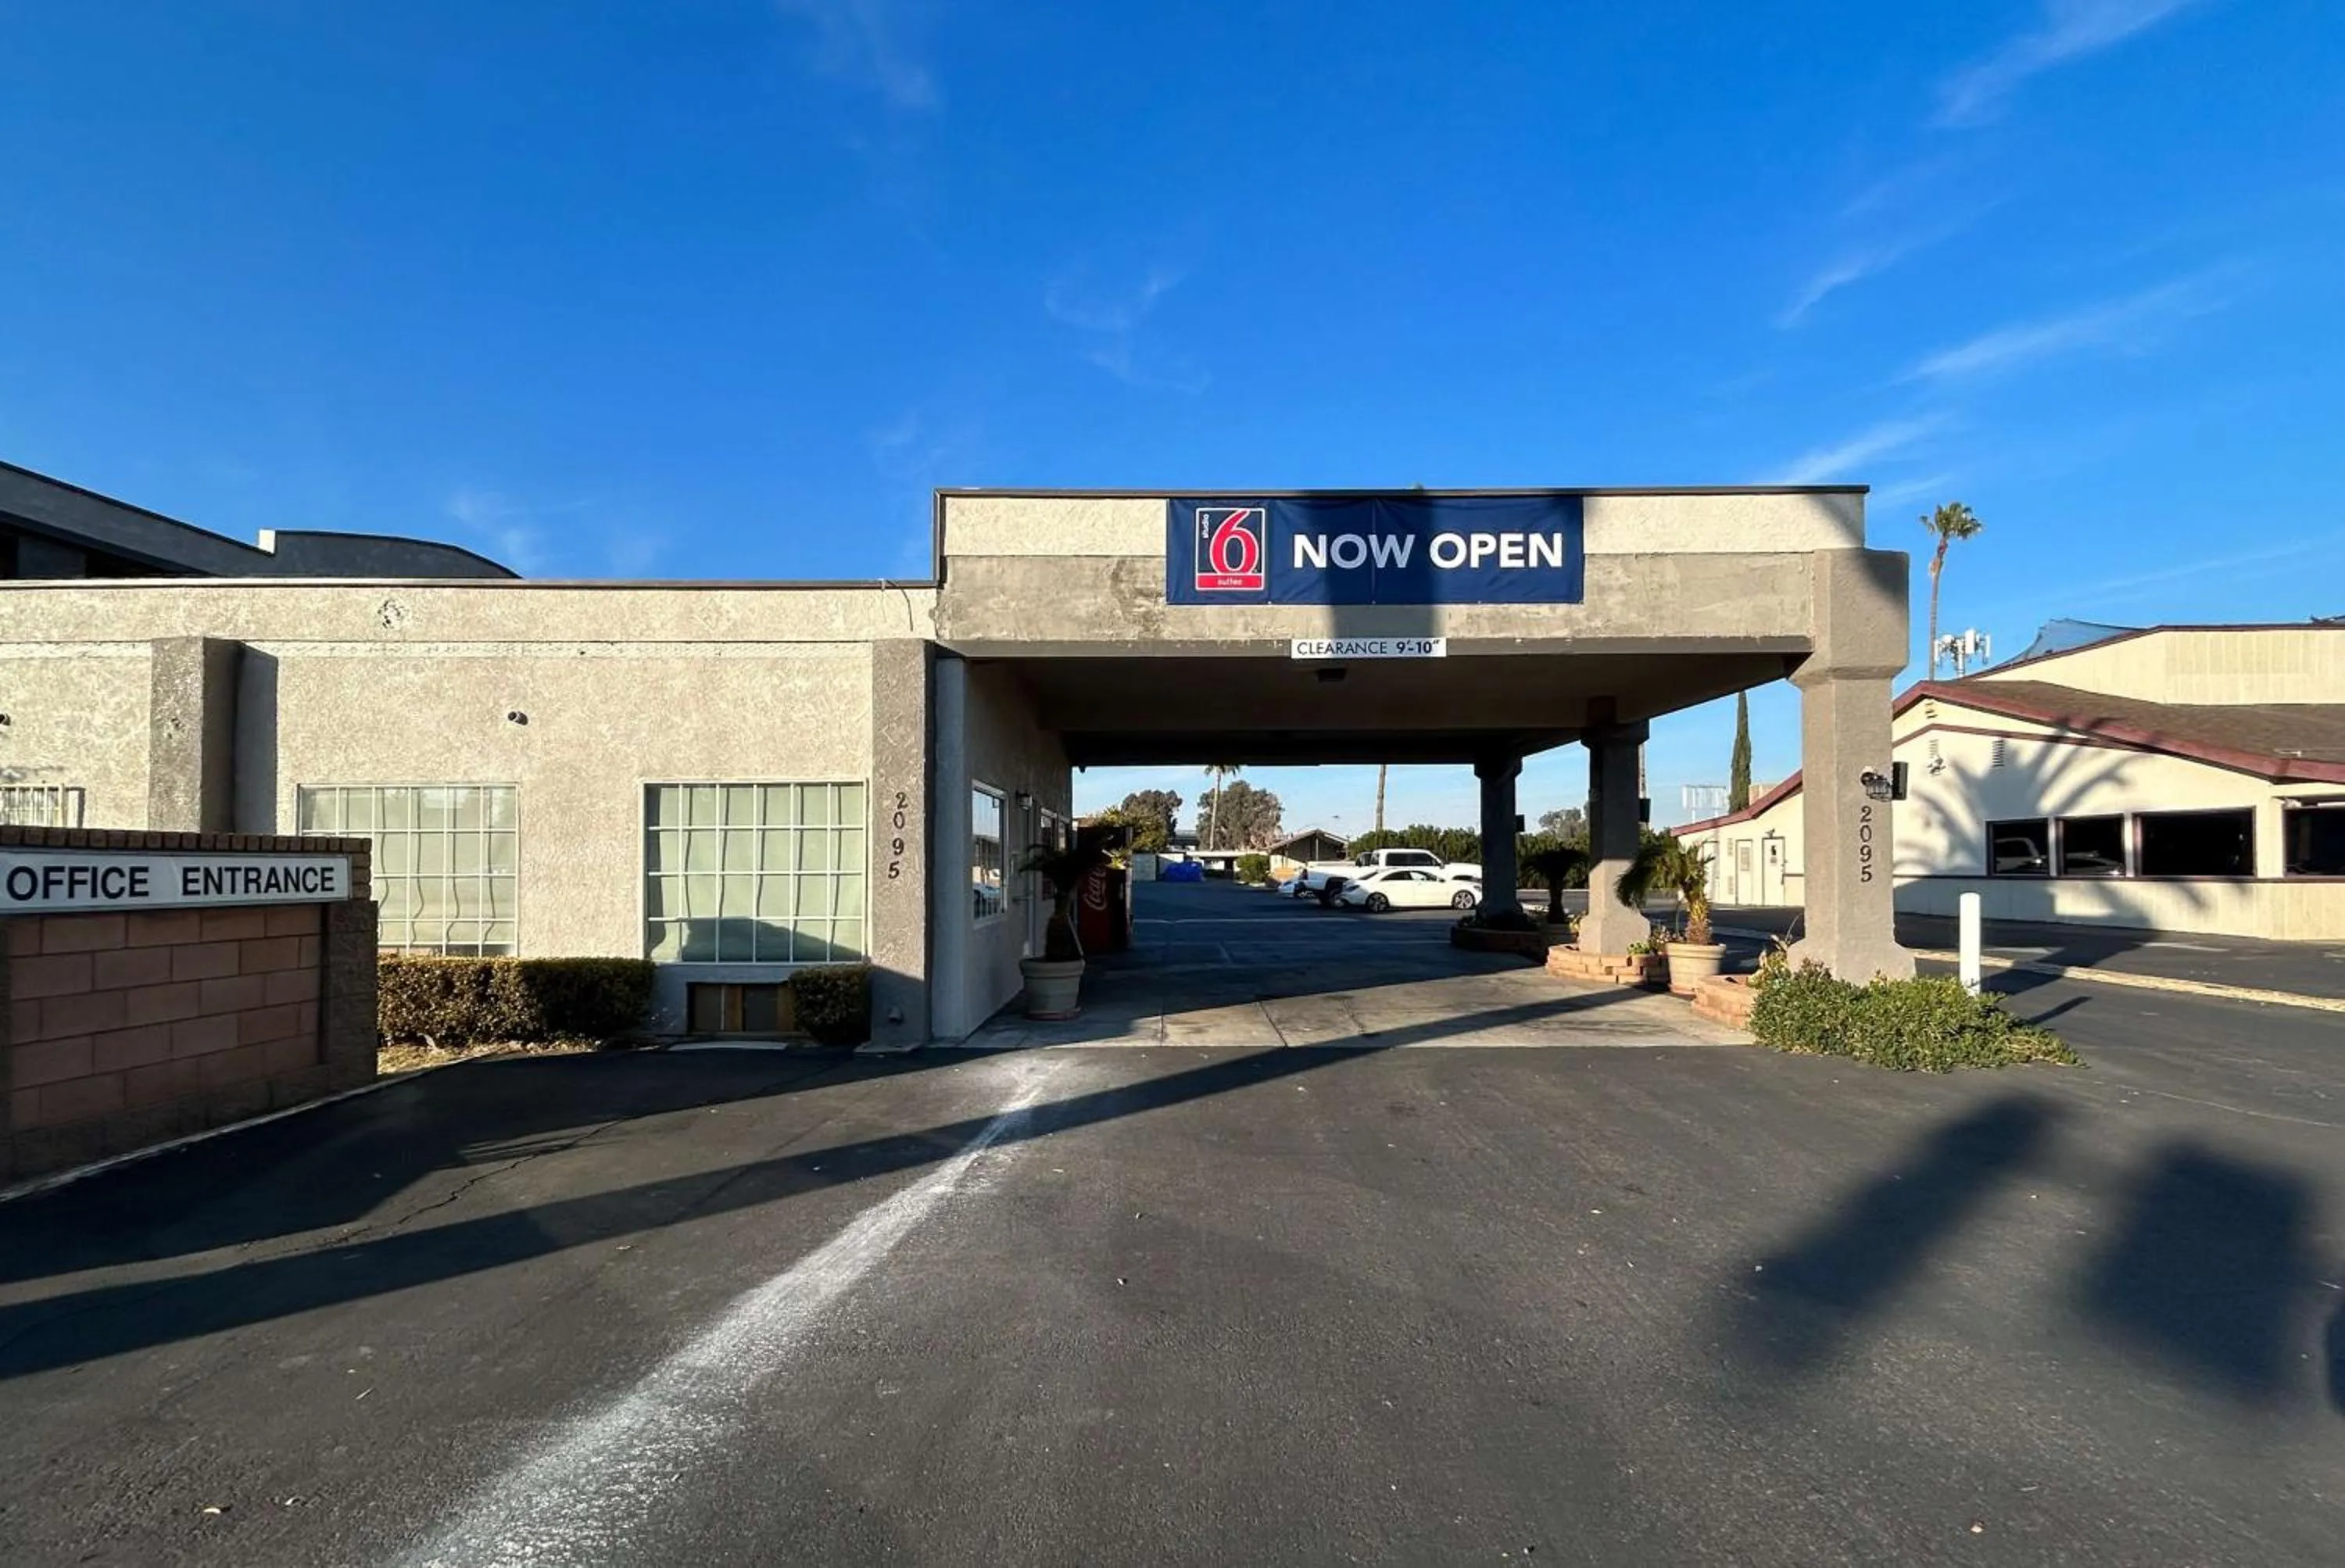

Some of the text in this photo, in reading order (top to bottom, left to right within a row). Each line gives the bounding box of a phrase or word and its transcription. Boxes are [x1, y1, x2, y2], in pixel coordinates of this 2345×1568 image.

[1209, 509, 1259, 575] 6
[1294, 532, 1563, 568] NOW OPEN
[1297, 641, 1387, 655] CLEARANCE
[888, 792, 908, 879] 2095
[1860, 805, 1873, 882] 2095
[6, 866, 335, 900] OFFICE ENTRANCE
